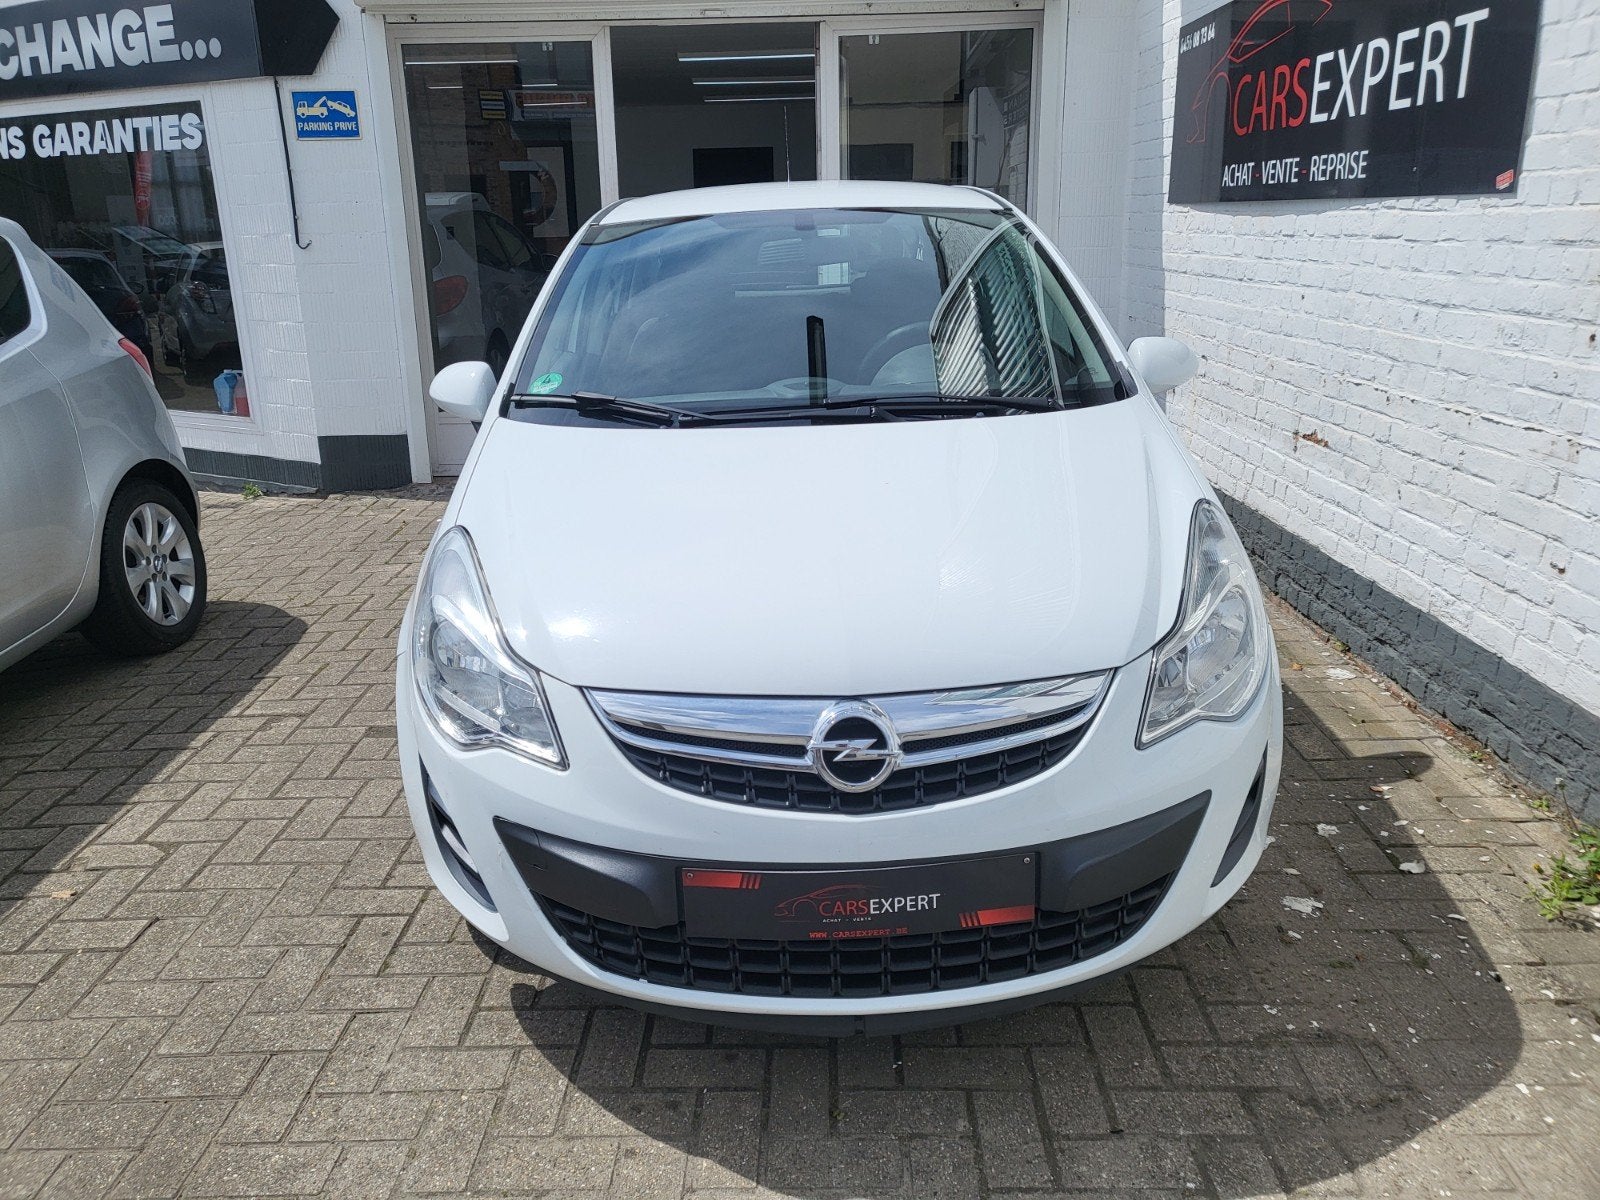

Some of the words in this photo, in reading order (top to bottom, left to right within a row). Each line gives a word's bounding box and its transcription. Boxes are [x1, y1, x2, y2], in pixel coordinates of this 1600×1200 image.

[1232, 7, 1490, 136] CARSEXPERT
[32, 112, 203, 158] GARANTIES
[298, 121, 333, 131] PARKING
[334, 121, 357, 131] PRIVE
[1222, 162, 1255, 187] ACHAT
[1261, 157, 1300, 184] VENTE
[1309, 150, 1369, 181] REPRISE
[820, 893, 941, 916] CARSEXPERT
